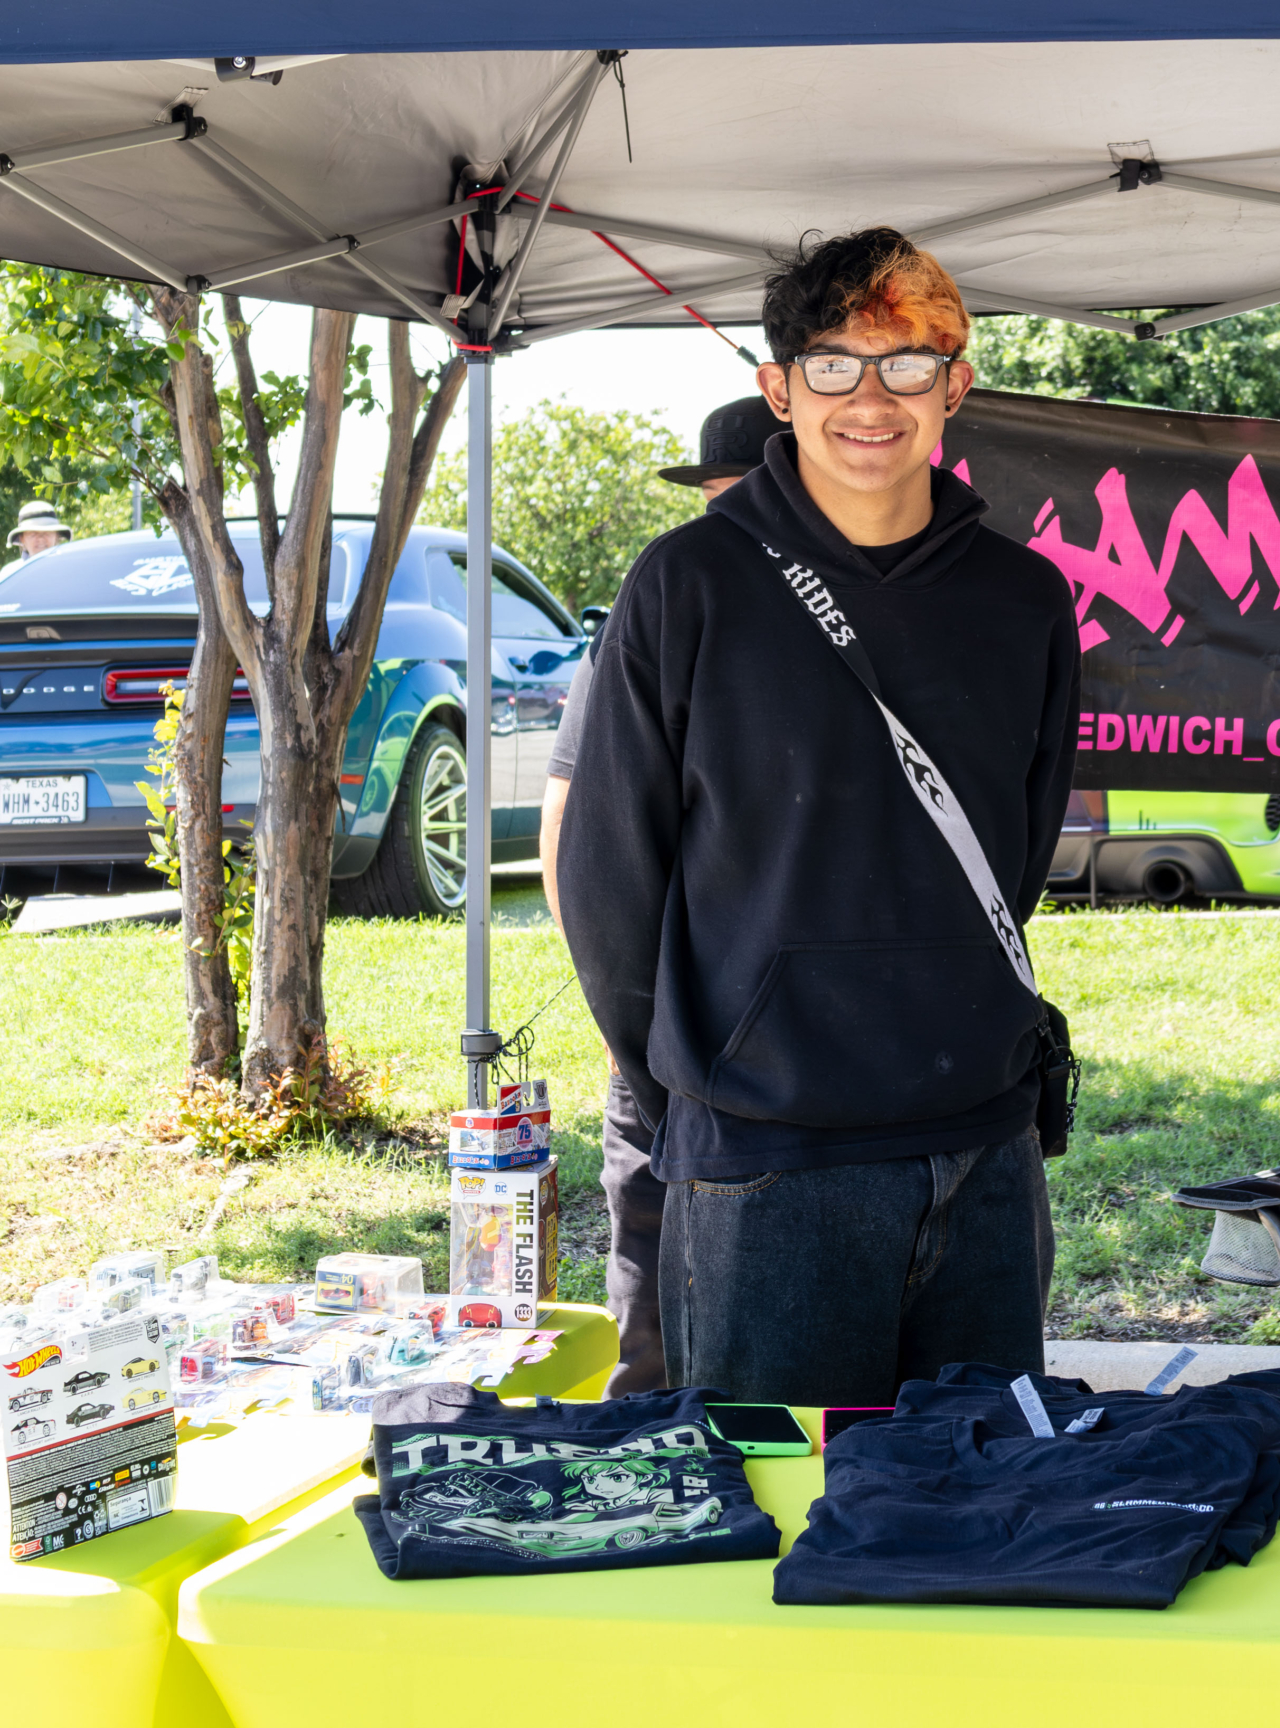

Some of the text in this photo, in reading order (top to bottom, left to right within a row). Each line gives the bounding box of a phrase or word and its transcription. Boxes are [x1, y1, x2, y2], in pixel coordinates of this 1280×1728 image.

[782, 562, 857, 647] RIDES
[2, 685, 95, 695] DODGE
[25, 779, 58, 789] TEXAS
[41, 791, 80, 813] 3463
[518, 1123, 532, 1140] 75
[457, 1175, 486, 1191] POP!
[494, 1184, 507, 1194] DC
[514, 1189, 535, 1294] THE FLASH
[515, 1305, 532, 1320] 1333
[17, 1345, 60, 1378] HOT WHEELS
